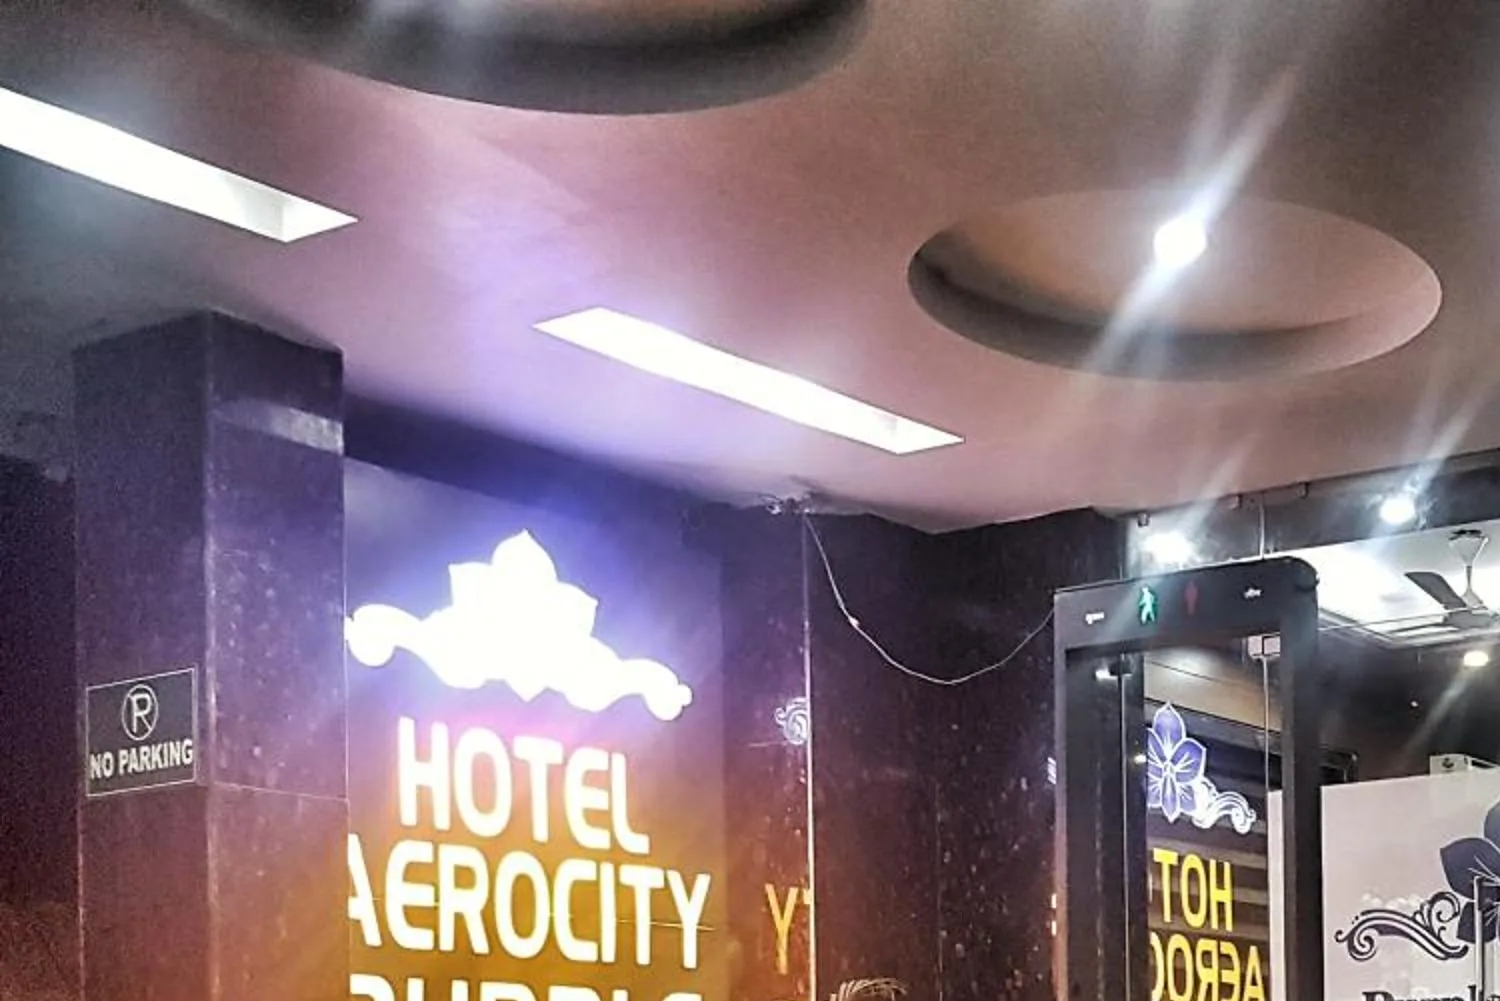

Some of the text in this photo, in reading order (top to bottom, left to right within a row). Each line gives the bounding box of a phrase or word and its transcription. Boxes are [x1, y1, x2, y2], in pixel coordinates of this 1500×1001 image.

[90, 738, 194, 779] NO PARKING
[398, 716, 650, 855] HOTEL
[348, 833, 711, 970] AEROCITY
